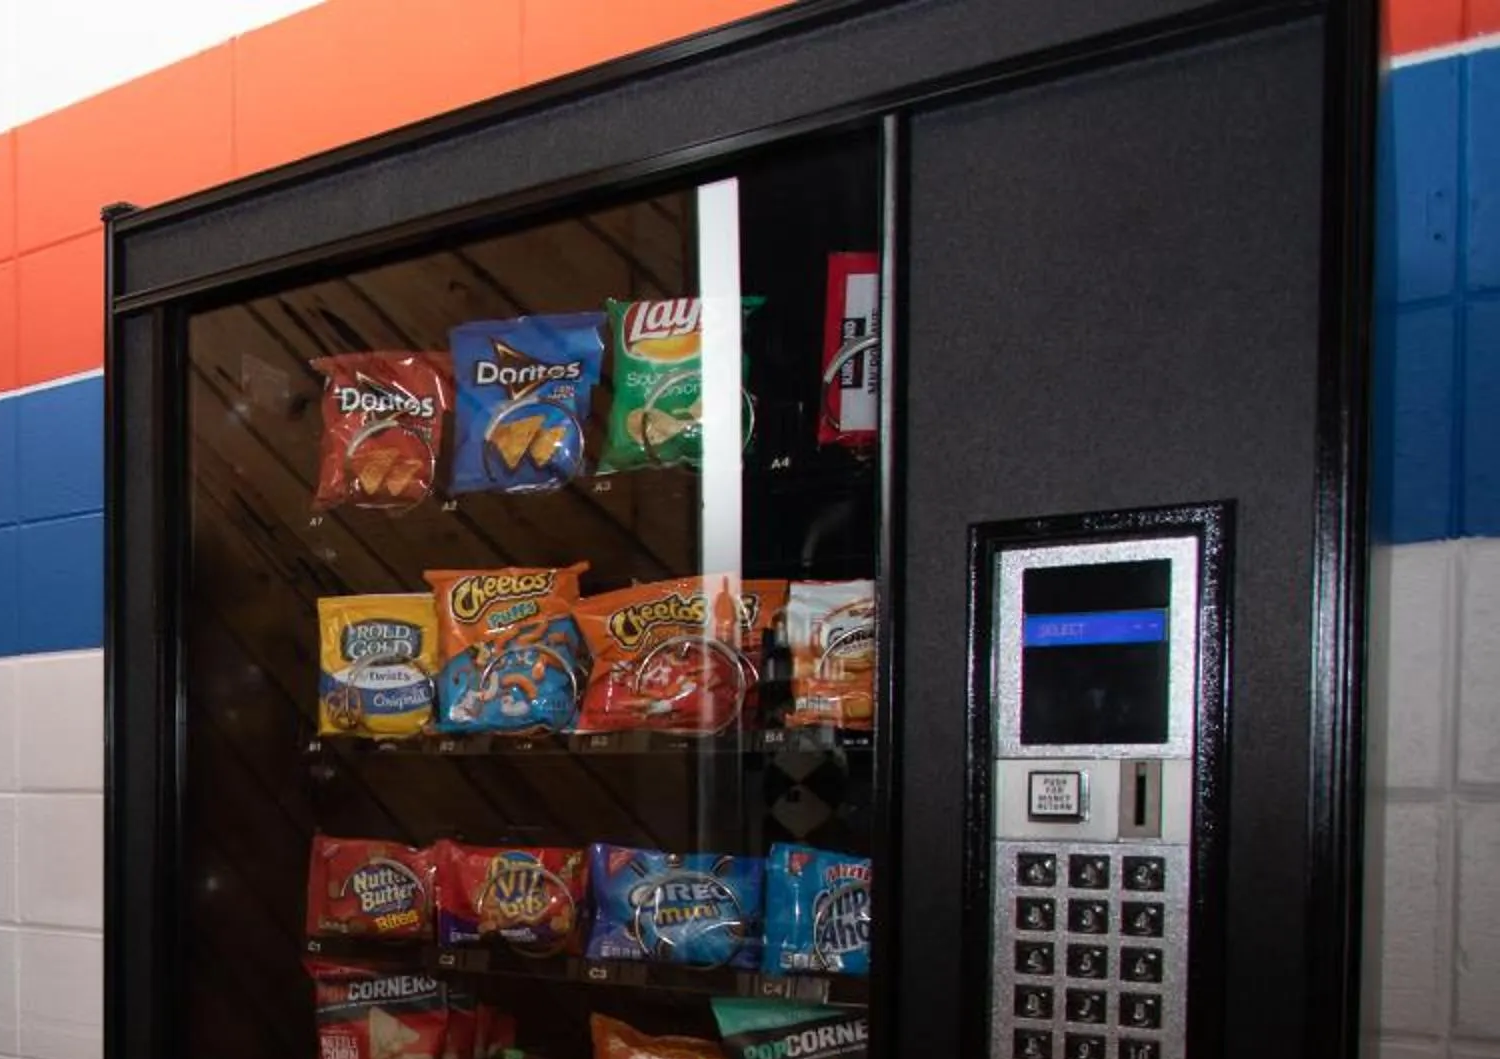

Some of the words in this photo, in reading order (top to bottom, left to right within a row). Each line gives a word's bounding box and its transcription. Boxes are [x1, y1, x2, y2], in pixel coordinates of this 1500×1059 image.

[629, 298, 701, 342] Lay
[477, 361, 581, 385] Doritos
[342, 387, 434, 417] Doritos
[771, 457, 790, 469] A4
[452, 572, 548, 621] Cheetos
[357, 625, 410, 640] ROLD
[611, 599, 708, 647] Cheetos
[348, 640, 413, 661] GOLD
